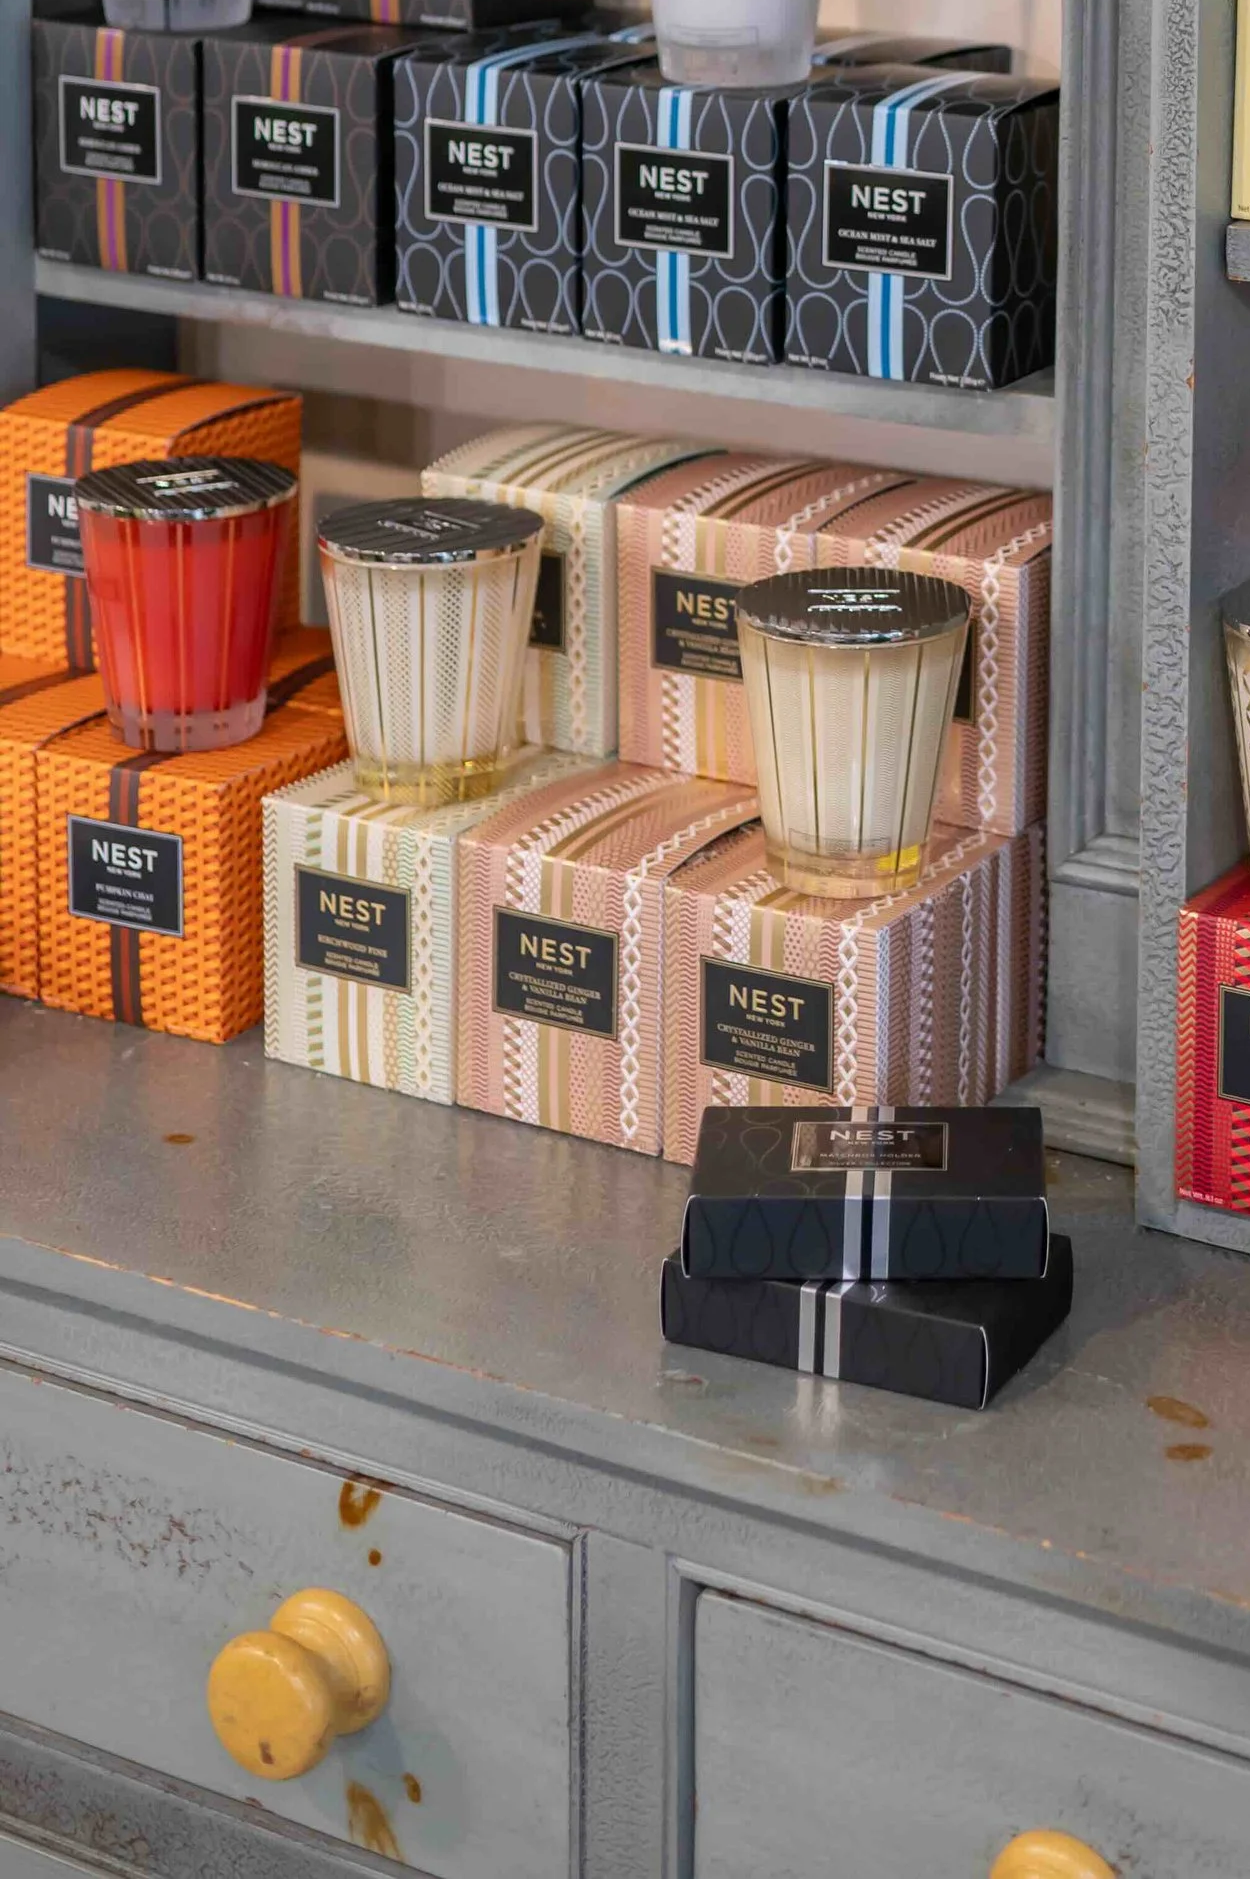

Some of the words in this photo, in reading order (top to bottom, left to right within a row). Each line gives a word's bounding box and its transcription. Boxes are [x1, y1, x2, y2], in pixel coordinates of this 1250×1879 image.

[80, 96, 139, 126] NEST
[254, 117, 317, 148] NEST
[448, 140, 515, 170] NEST
[640, 164, 709, 195] NEST
[851, 184, 926, 214] NEST
[92, 838, 158, 872] NEST
[320, 890, 386, 926] NEST
[520, 932, 591, 969] NEST
[729, 984, 805, 1020] NEST
[830, 1131, 915, 1141] NEST
